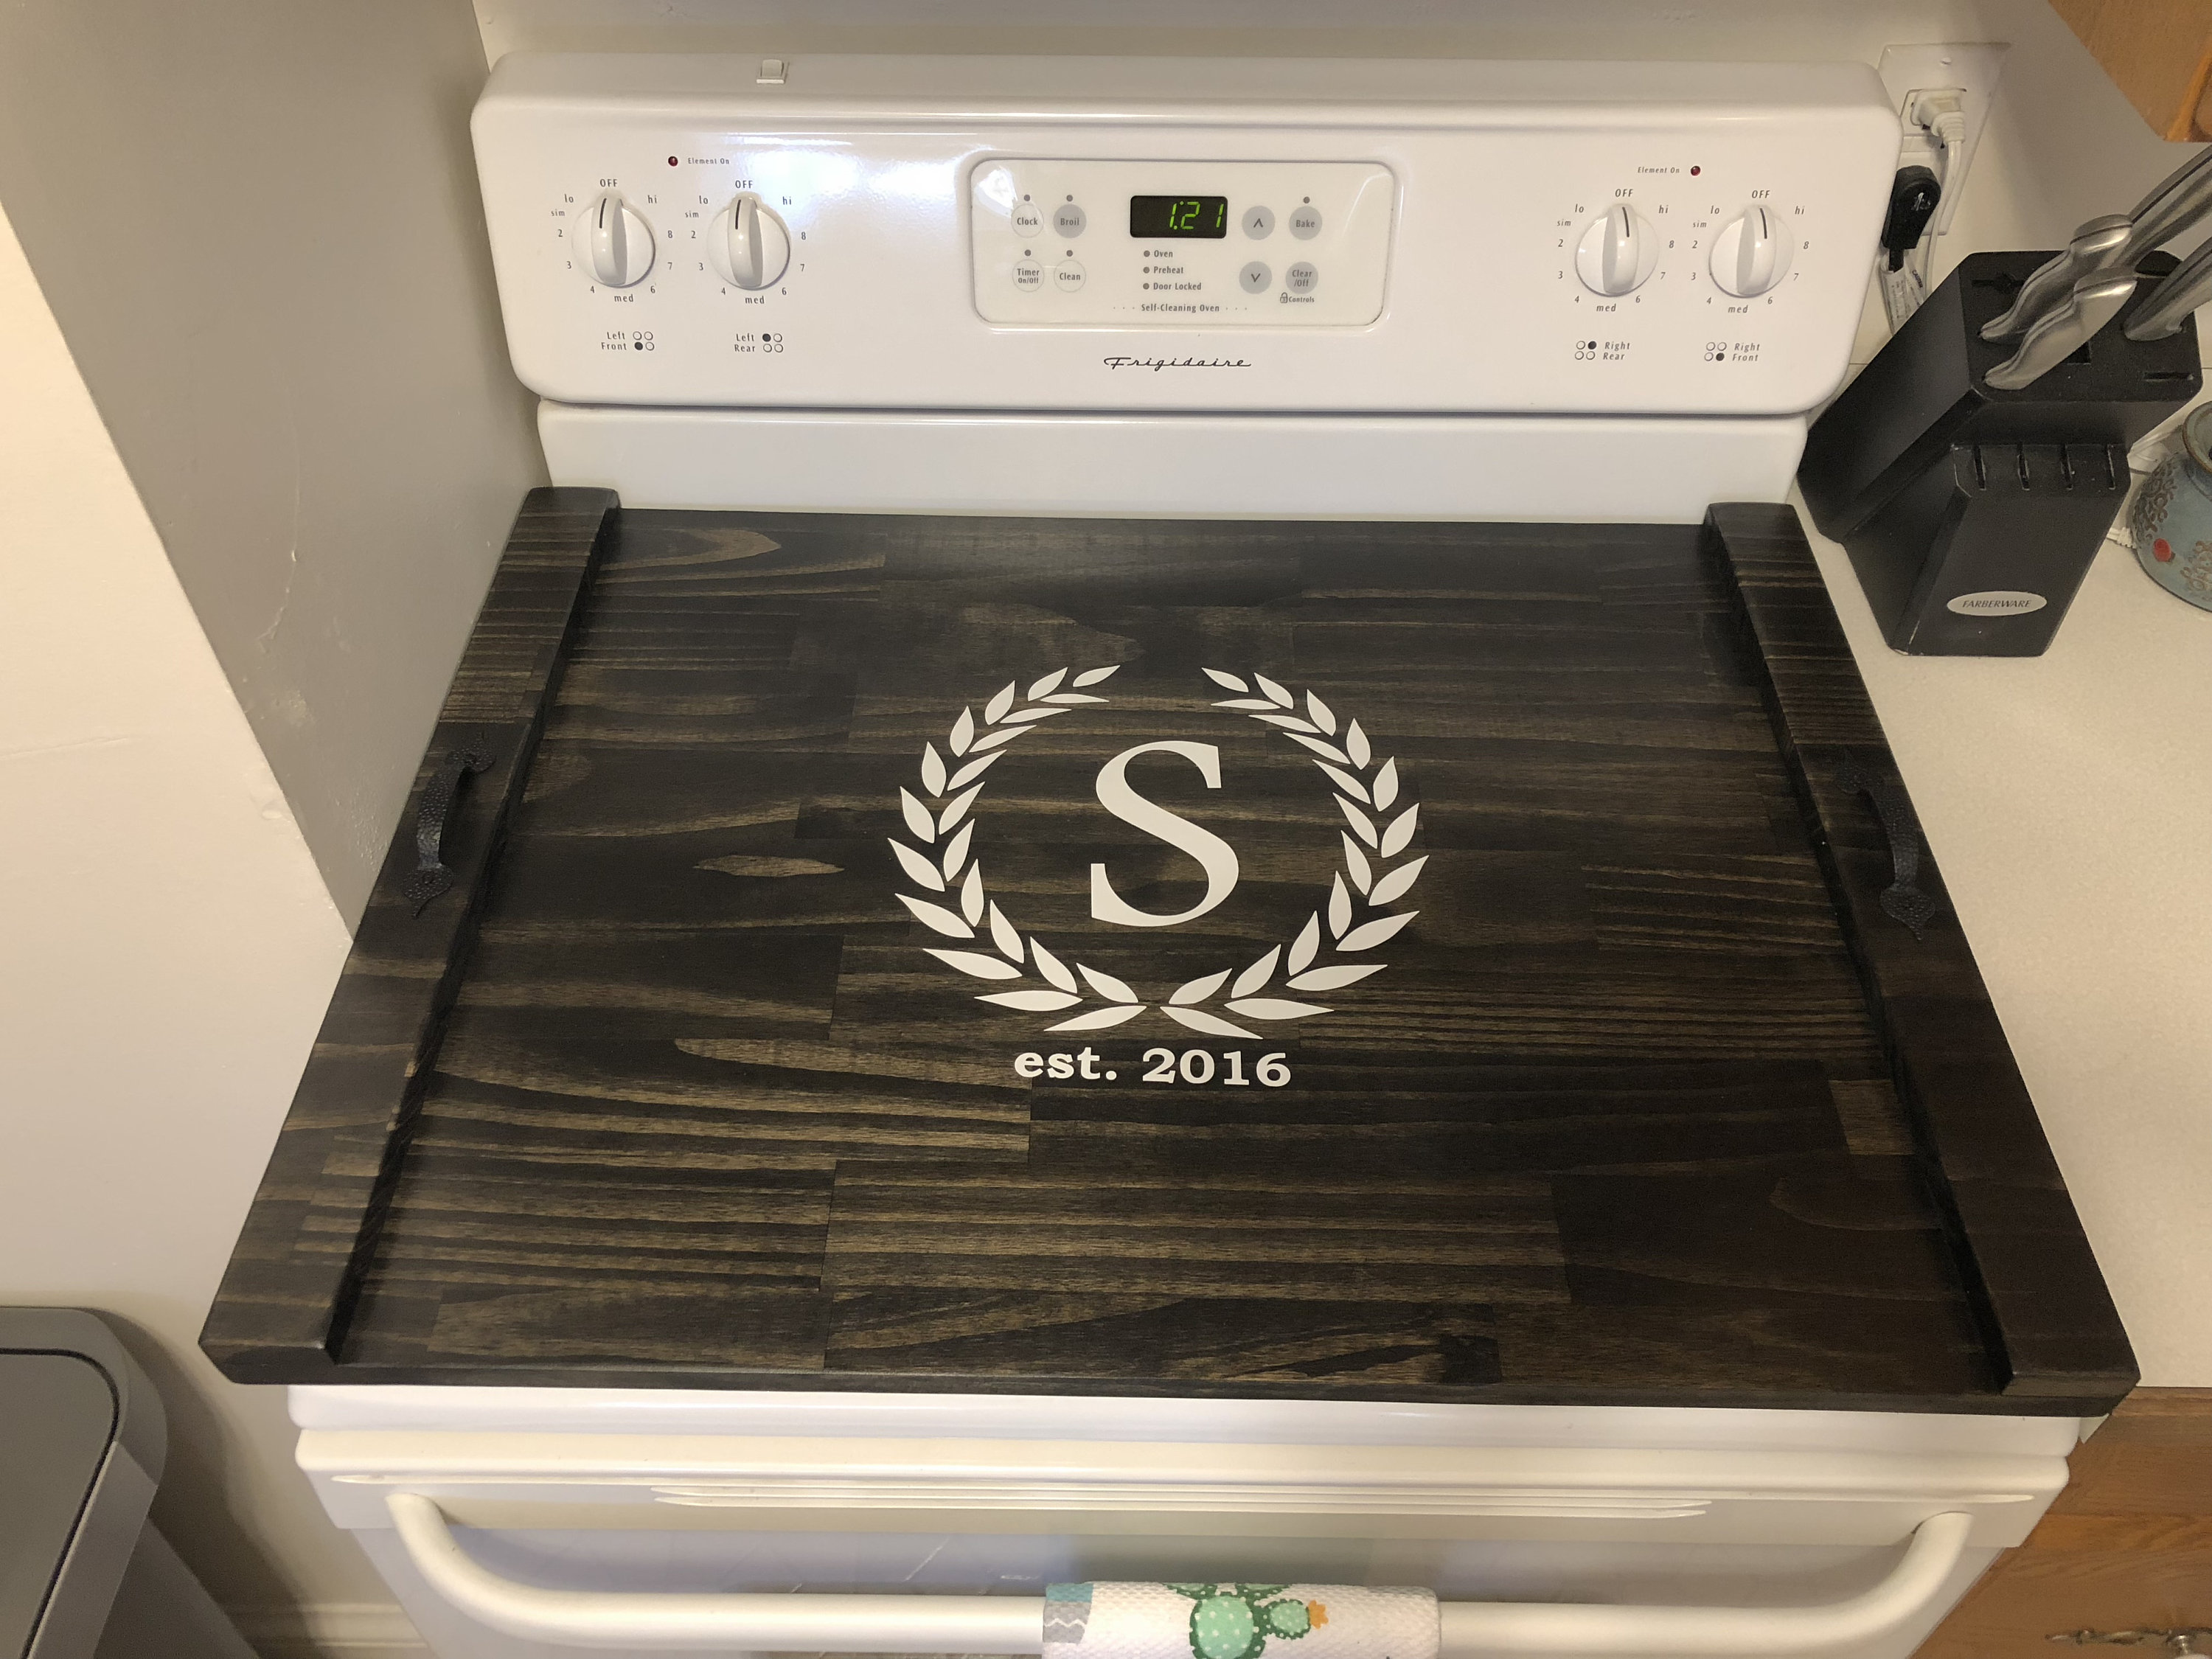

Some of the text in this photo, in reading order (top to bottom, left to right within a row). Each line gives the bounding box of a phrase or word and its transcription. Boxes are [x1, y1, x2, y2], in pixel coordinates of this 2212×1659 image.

[686, 156, 717, 165] Element
[599, 178, 618, 187] OFF
[734, 180, 753, 189] OFF
[1615, 188, 1633, 198] OFF
[1751, 189, 1770, 199] OFF
[564, 193, 574, 204] lo
[647, 195, 657, 204] hi
[699, 195, 709, 204] lo
[782, 195, 792, 206] hi
[1574, 204, 1585, 213] lo
[1658, 204, 1669, 214] hi
[1710, 205, 1720, 215] lo
[1795, 205, 1804, 215] hi
[1017, 217, 1038, 226] Clock
[1060, 218, 1079, 226] Broil
[1295, 219, 1315, 228] Bake
[557, 229, 563, 237] 2
[667, 230, 673, 239] 8
[691, 230, 696, 239] 2
[801, 232, 807, 240] 8
[1558, 238, 1564, 248] 2
[1669, 240, 1674, 249] 8
[1691, 240, 1698, 249] 2
[1803, 240, 1809, 250] 8
[1153, 249, 1173, 258] Oven
[566, 260, 572, 269] 3
[667, 262, 672, 271] 7
[699, 262, 704, 271] 3
[800, 263, 805, 272] 7
[1017, 268, 1040, 276] Timer
[1153, 265, 1183, 274] Preheat
[1292, 269, 1312, 277] Clear
[1059, 272, 1081, 280] Clean
[1558, 271, 1563, 279] 3
[1660, 271, 1666, 279] 7
[1691, 272, 1697, 281] 3
[1793, 272, 1799, 281] 7
[1153, 282, 1202, 291] Door Locked
[1294, 278, 1309, 287] /Off
[590, 285, 595, 293] 4
[650, 285, 655, 293] 6
[721, 287, 726, 296] 4
[782, 287, 787, 296] 6
[613, 293, 634, 302] med
[745, 295, 765, 305] med
[1574, 295, 1579, 303] 4
[1635, 295, 1641, 304] 6
[1706, 296, 1712, 305] 4
[1767, 296, 1773, 305] 6
[1141, 303, 1220, 313] Self-Cleaning Oven
[1596, 303, 1617, 312] med
[1728, 305, 1748, 313] med
[606, 331, 625, 340] Left
[736, 333, 754, 342] Left
[601, 341, 627, 351] Front
[734, 344, 756, 352] Rear
[1604, 341, 1630, 352] Right
[1734, 342, 1760, 353] Right
[1603, 352, 1625, 361] Rear
[1732, 353, 1759, 362] Front
[1103, 357, 1252, 372] Frigidaire
[1962, 599, 2032, 608] FARBERWARE
[1091, 740, 1239, 927] S
[1014, 1046, 1291, 1087] est. 2016
